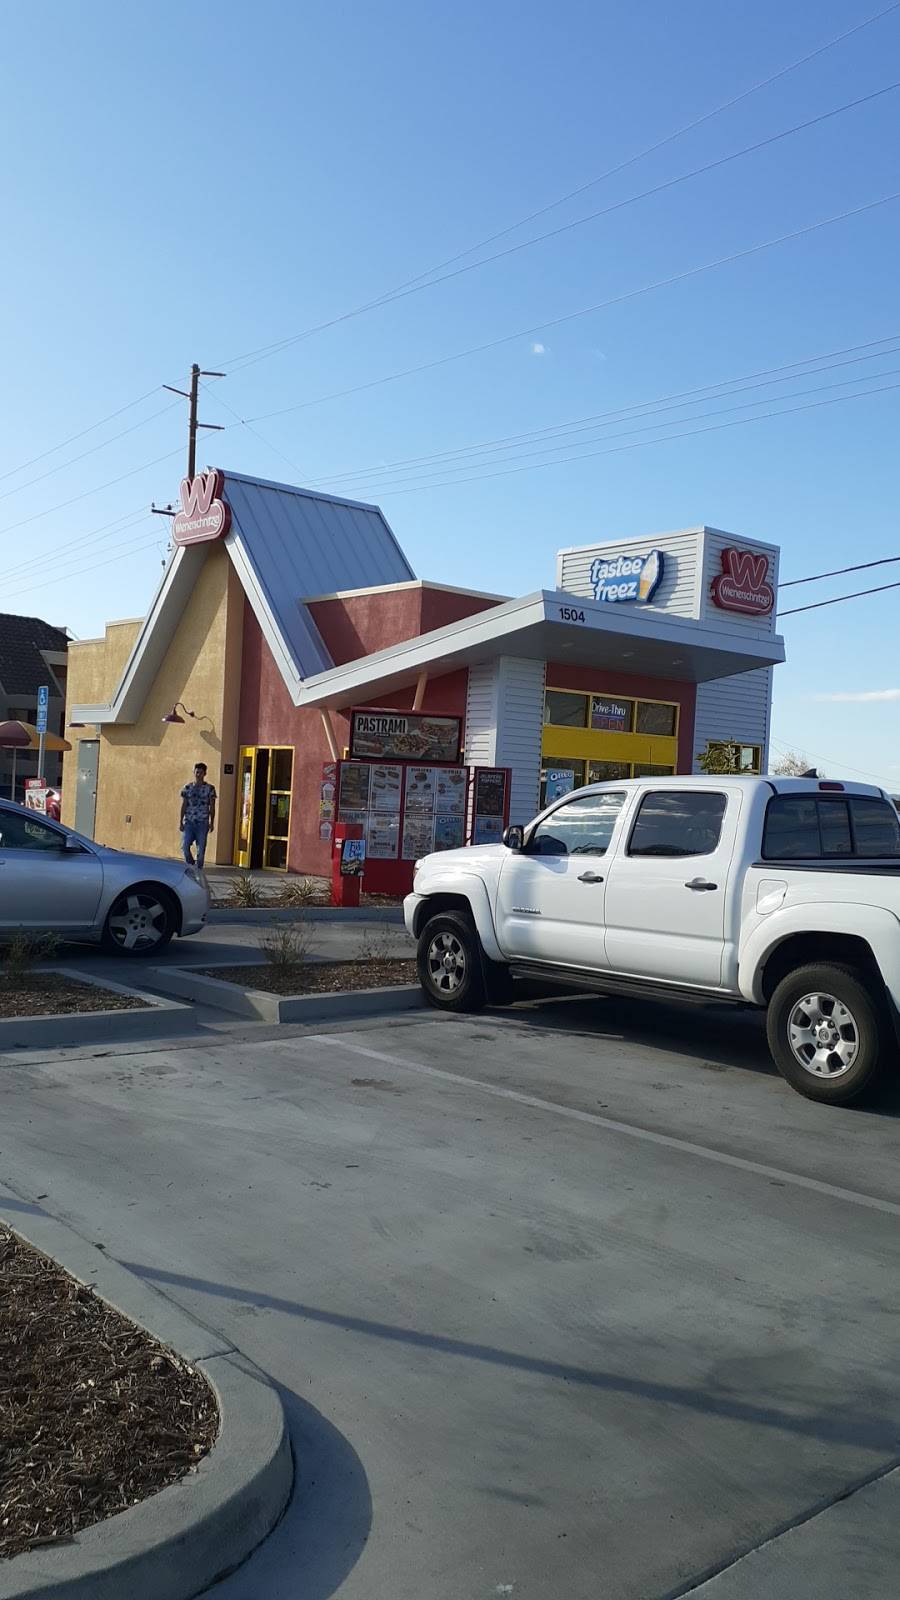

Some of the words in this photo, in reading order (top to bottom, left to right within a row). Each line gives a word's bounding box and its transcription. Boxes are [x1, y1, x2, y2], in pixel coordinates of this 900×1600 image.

[181, 471, 216, 518] W
[590, 556, 643, 584] tastee
[729, 550, 767, 590] W
[593, 580, 637, 603] freez
[721, 586, 770, 606] Wienerschnitzel
[559, 607, 586, 623] 1504
[592, 701, 626, 716] Drive-Thru
[357, 717, 406, 734] PASTRAMI
[550, 771, 573, 781] OREO
